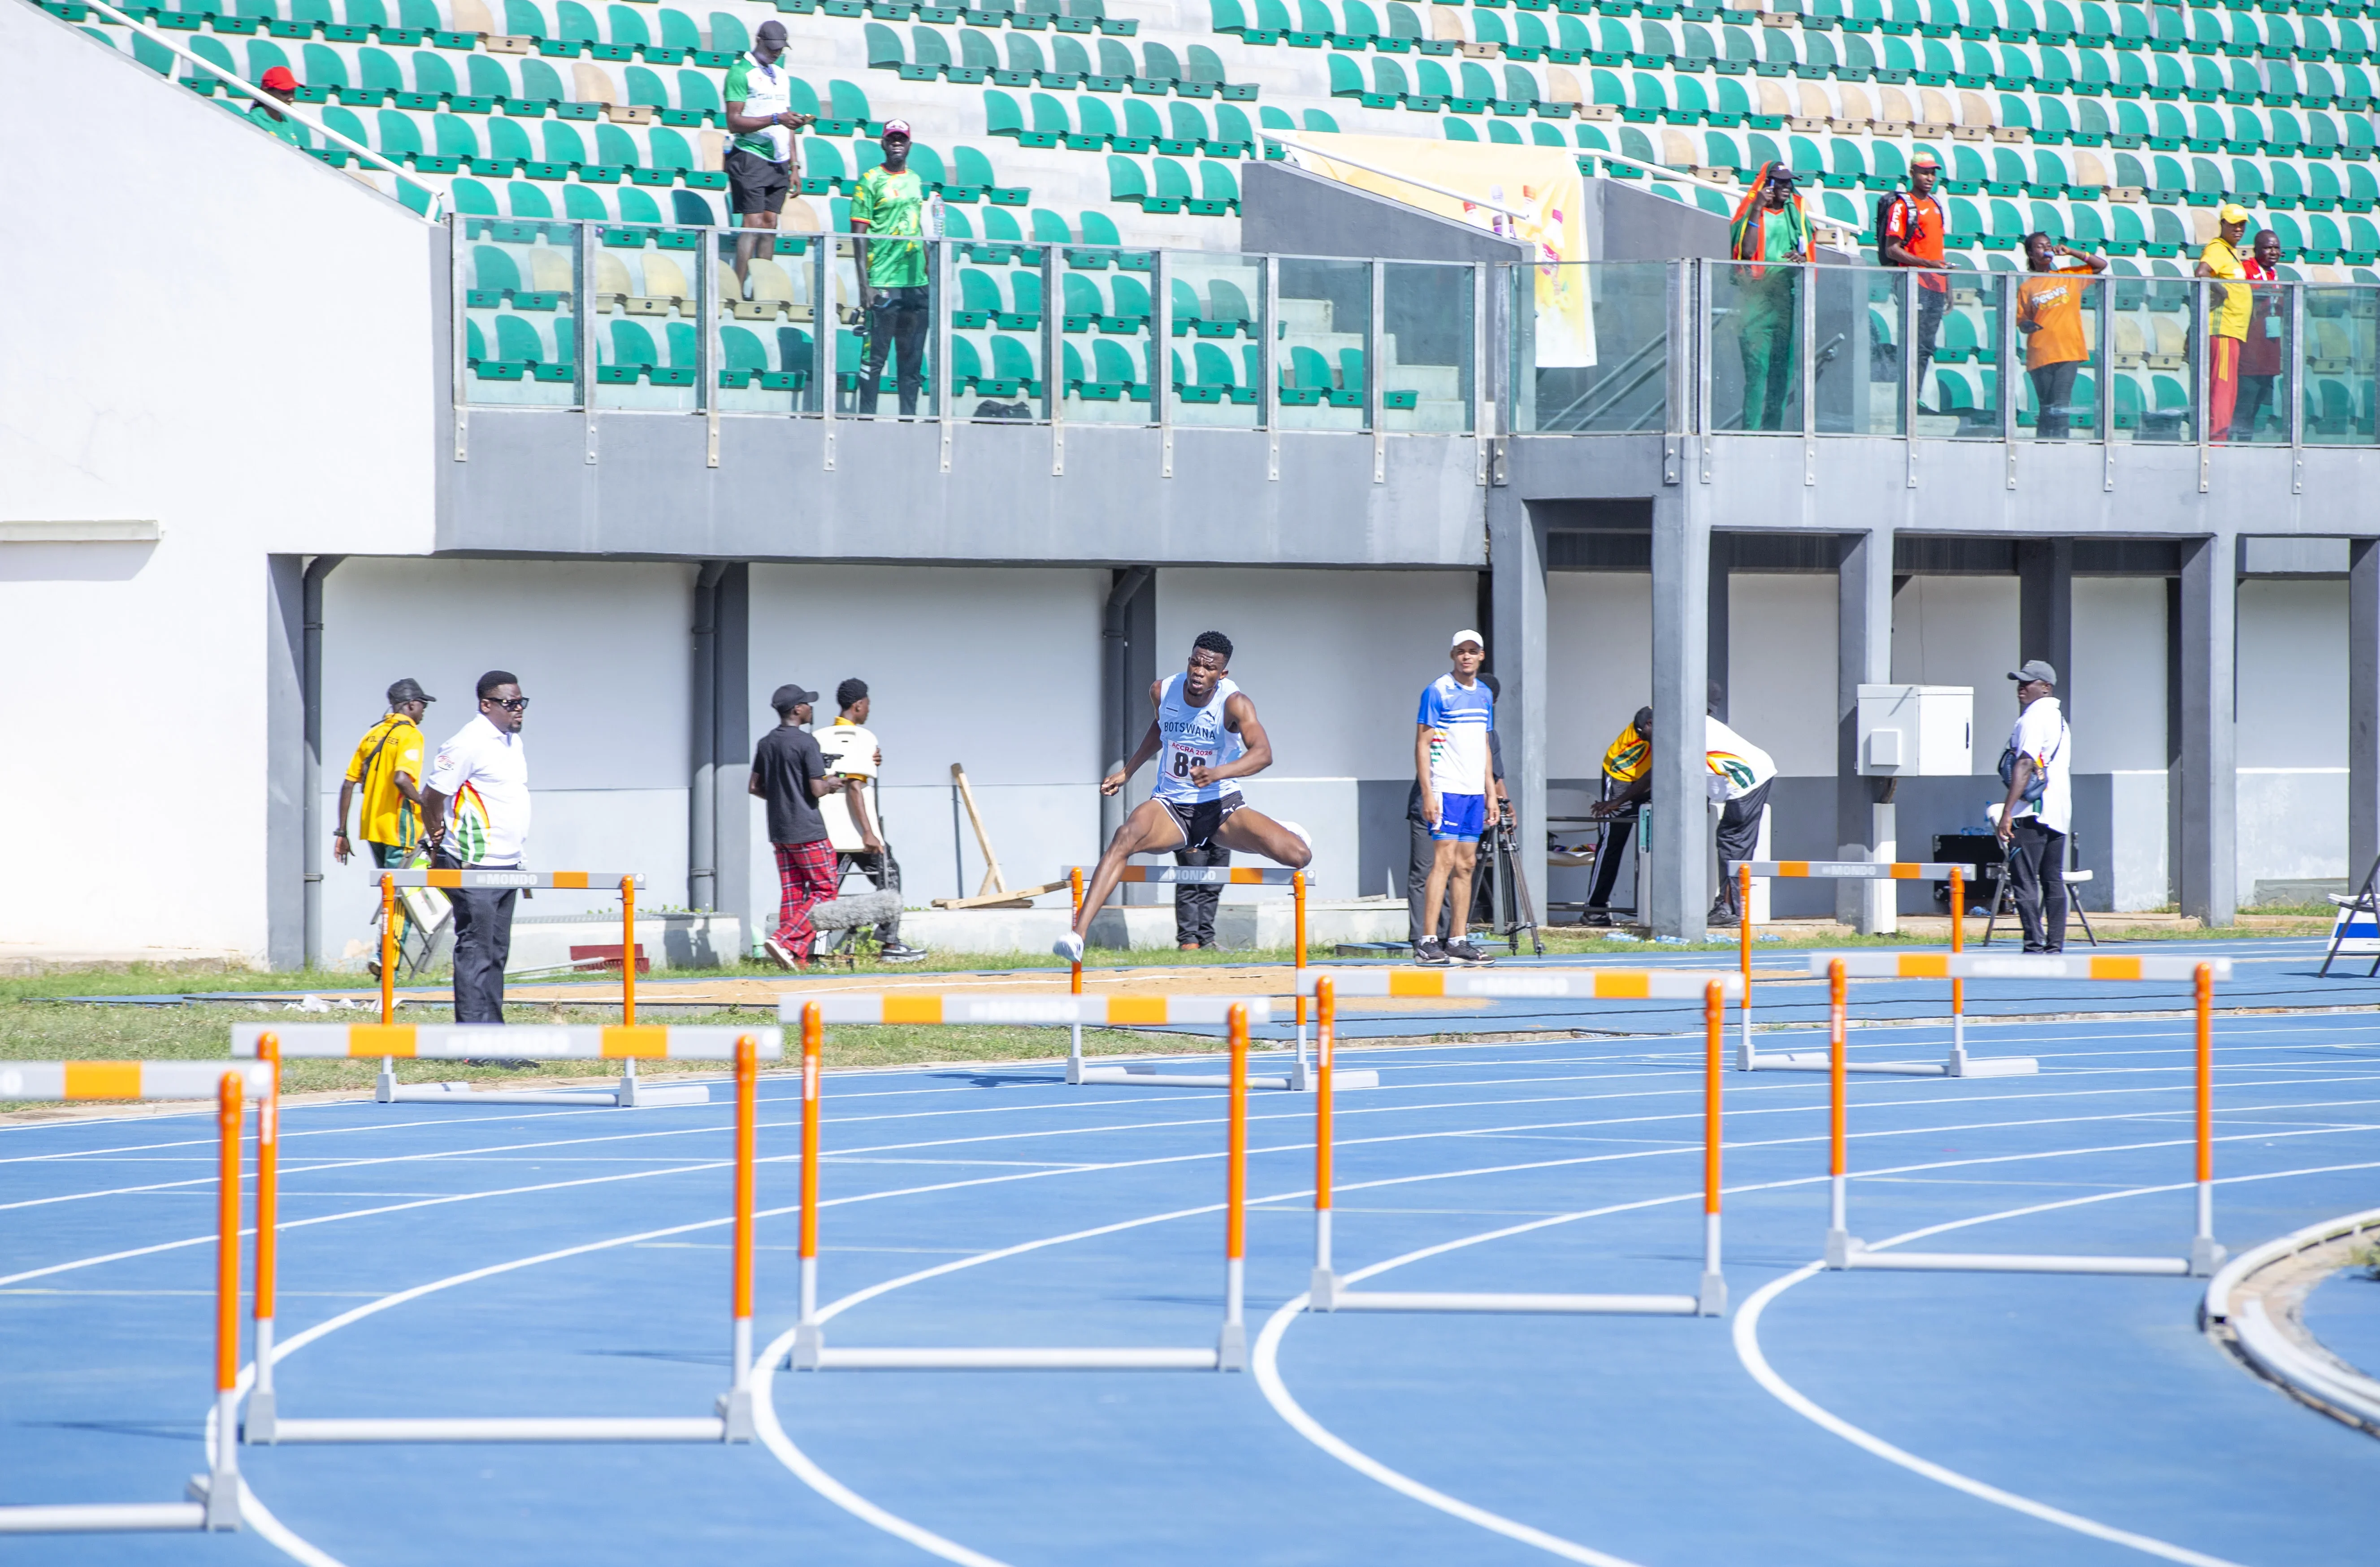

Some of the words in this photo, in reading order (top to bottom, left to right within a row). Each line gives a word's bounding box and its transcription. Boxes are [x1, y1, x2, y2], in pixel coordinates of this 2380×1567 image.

[1890, 203, 1903, 232] KEN
[1164, 722, 1215, 739] BOTSWANA
[1172, 742, 1194, 754] ACCRA
[1168, 870, 1216, 880] MONDO
[1831, 865, 1877, 875] MONDO
[486, 873, 538, 885] MONDO
